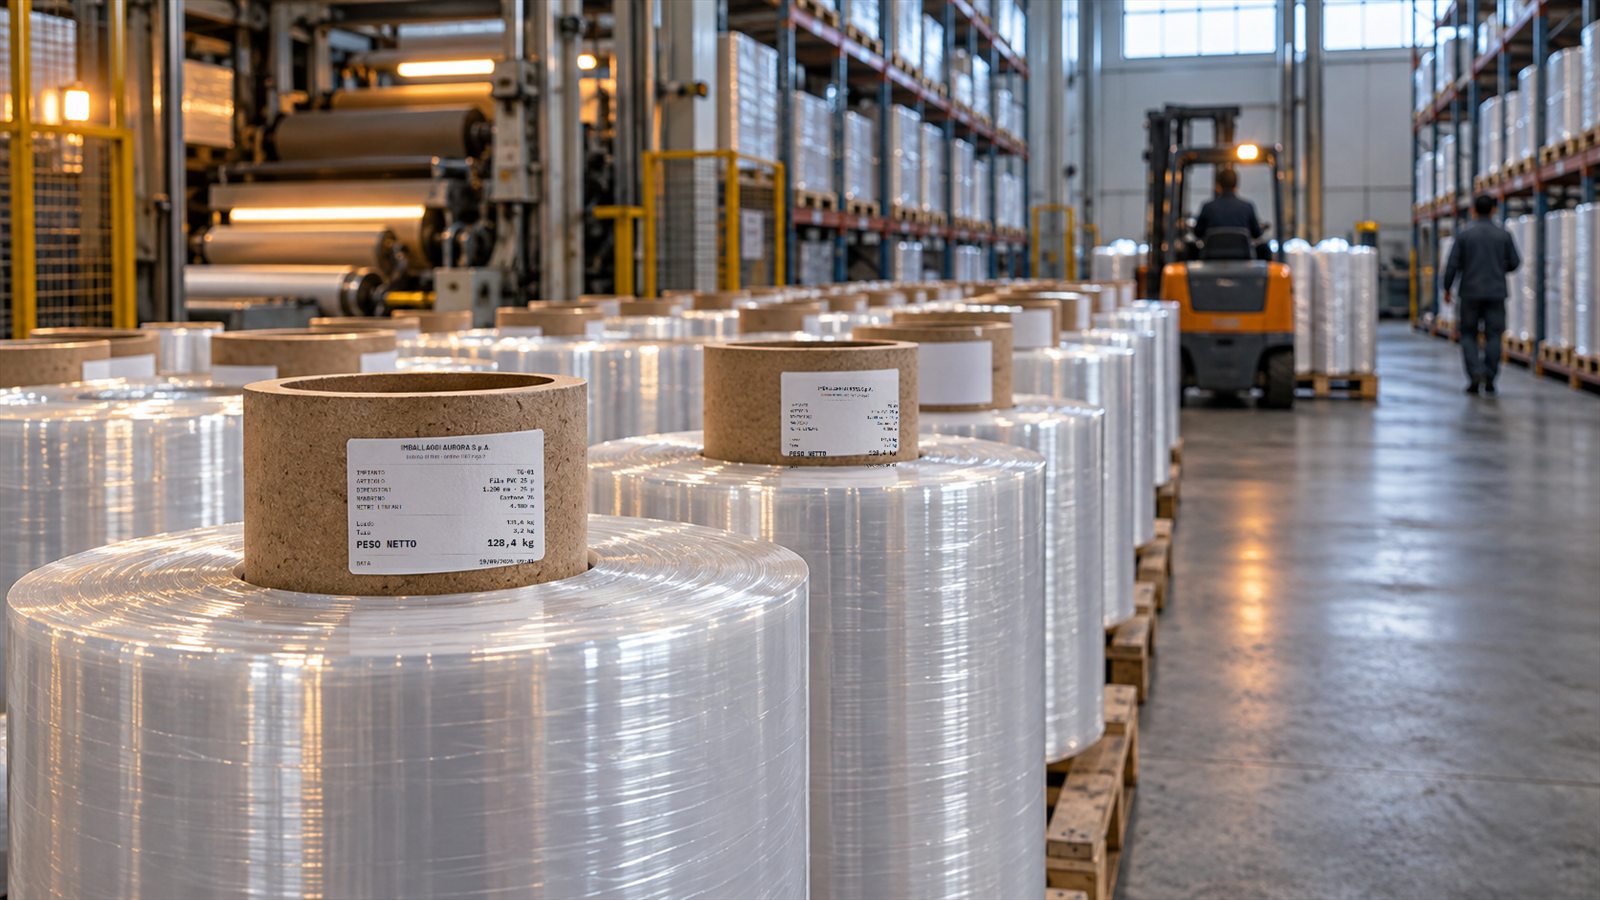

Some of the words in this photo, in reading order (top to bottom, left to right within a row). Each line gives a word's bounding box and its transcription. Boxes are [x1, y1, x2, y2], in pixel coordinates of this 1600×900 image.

[356, 540, 381, 548] PESO
[387, 540, 417, 548] NETTO
[488, 539, 516, 548] 128,4
[522, 538, 534, 548] kg
